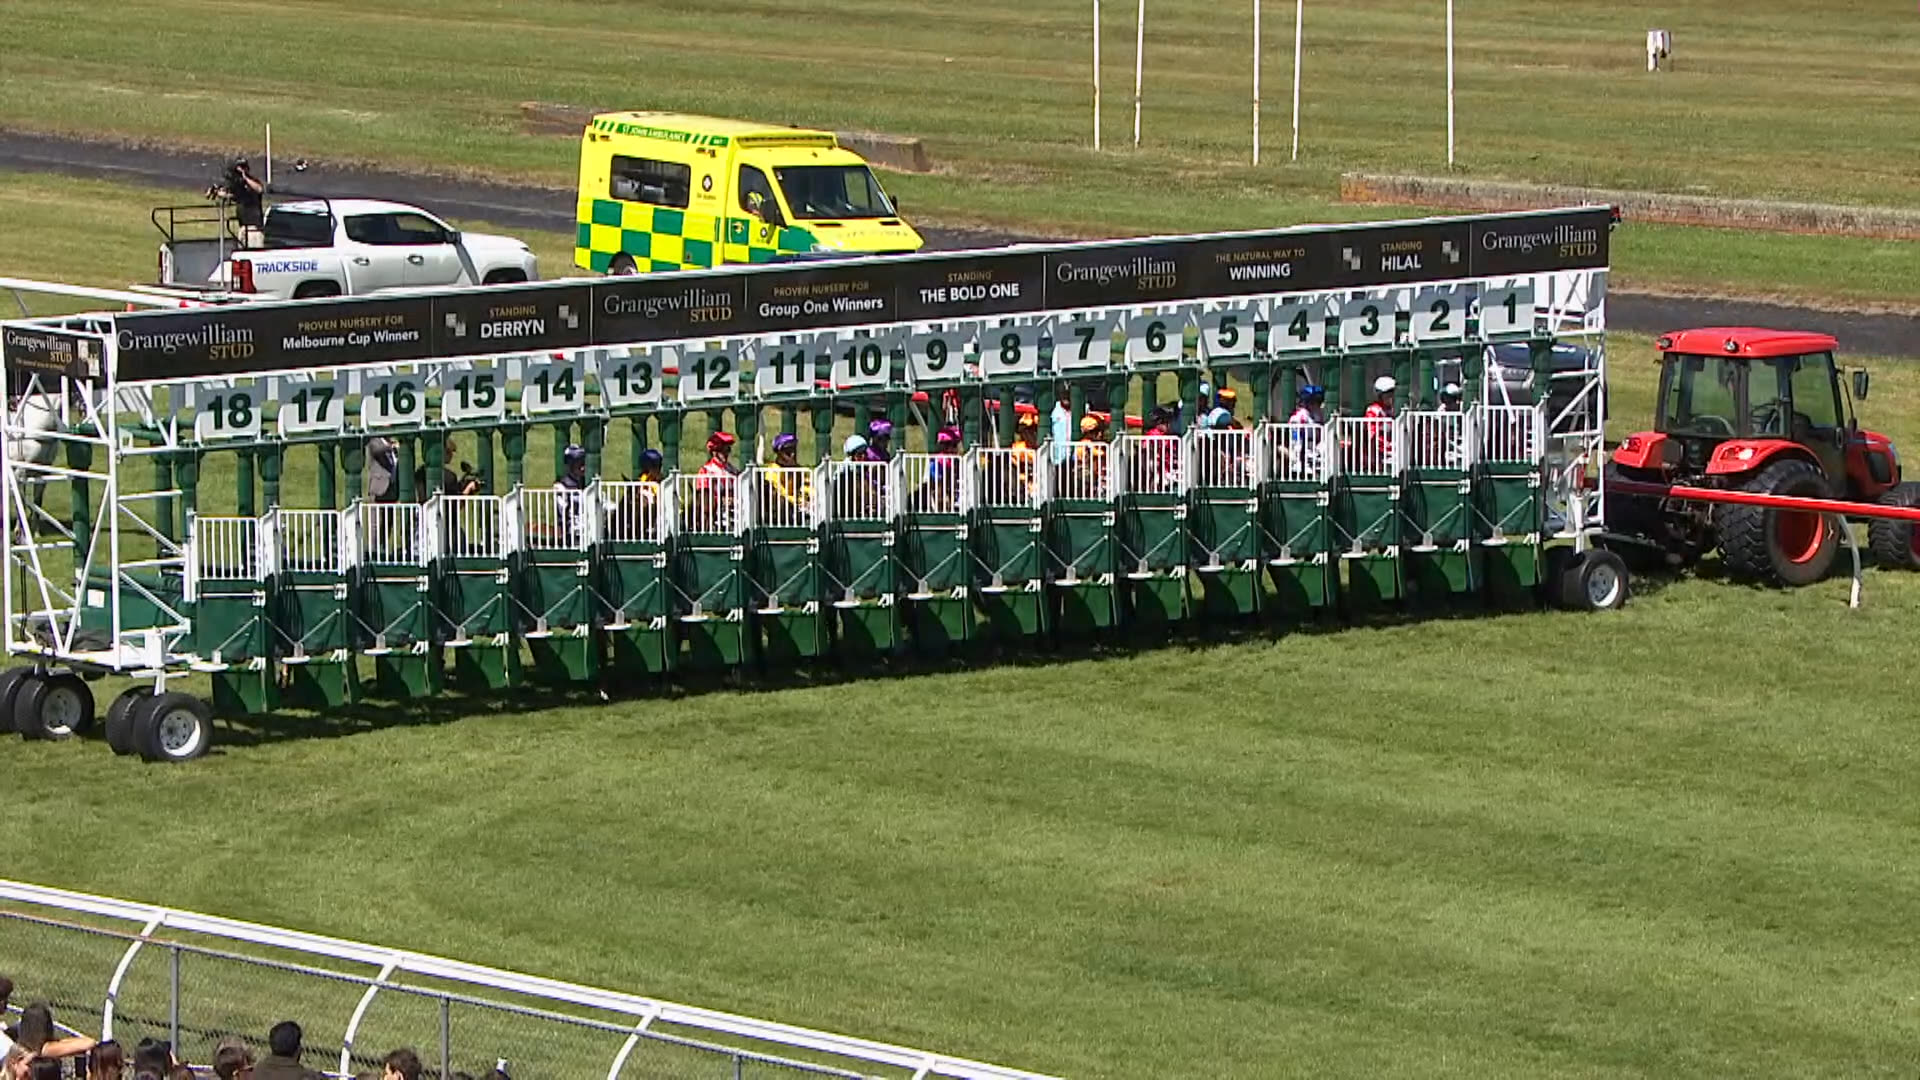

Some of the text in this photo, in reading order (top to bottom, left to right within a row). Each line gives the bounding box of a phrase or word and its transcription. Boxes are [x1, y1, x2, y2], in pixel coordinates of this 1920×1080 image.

[1381, 241, 1422, 252] STANDING
[1483, 225, 1596, 250] Grangewilliam
[1560, 243, 1596, 258] STUD
[256, 260, 318, 274] TRACKSIDE
[1056, 256, 1176, 285] Grangewilliam
[1216, 248, 1305, 264] THE NATURAL WAY TO
[1382, 255, 1422, 272] HILAL
[948, 270, 992, 282] STANDING
[1138, 274, 1176, 290] STUD
[1230, 264, 1290, 280] WINNING
[604, 288, 731, 318] Grangewilliam
[774, 280, 869, 297] PROVEN NURSERY FOR
[920, 283, 1020, 304] THE BOLD ONE
[490, 305, 536, 319] STANDING
[690, 306, 732, 323] STUD
[760, 296, 884, 319] Group One Winners
[1360, 305, 1379, 336] 3
[1430, 300, 1450, 332] 2
[1503, 292, 1516, 324] 1
[298, 315, 404, 332] PROVEN NURSERY FOR
[480, 320, 544, 338] DERRYN
[1146, 321, 1166, 352] 6
[1218, 315, 1238, 348] 5
[1288, 309, 1310, 342] 4
[6, 330, 72, 352] Grangewilliam
[117, 324, 253, 353] Grangewilliam
[208, 343, 254, 360] STUD
[283, 330, 420, 350] Melbourne Cup Winners
[1000, 334, 1020, 364] 8
[1074, 327, 1095, 360] 7
[50, 351, 72, 364] STUD
[770, 350, 804, 384] 11
[844, 343, 882, 378] 10
[926, 339, 948, 371] 9
[534, 367, 576, 404] 14
[614, 362, 653, 396] 13
[691, 356, 731, 390] 12
[292, 388, 334, 424] 17
[374, 381, 416, 416] 16
[454, 374, 496, 410] 15
[208, 392, 252, 430] 18
